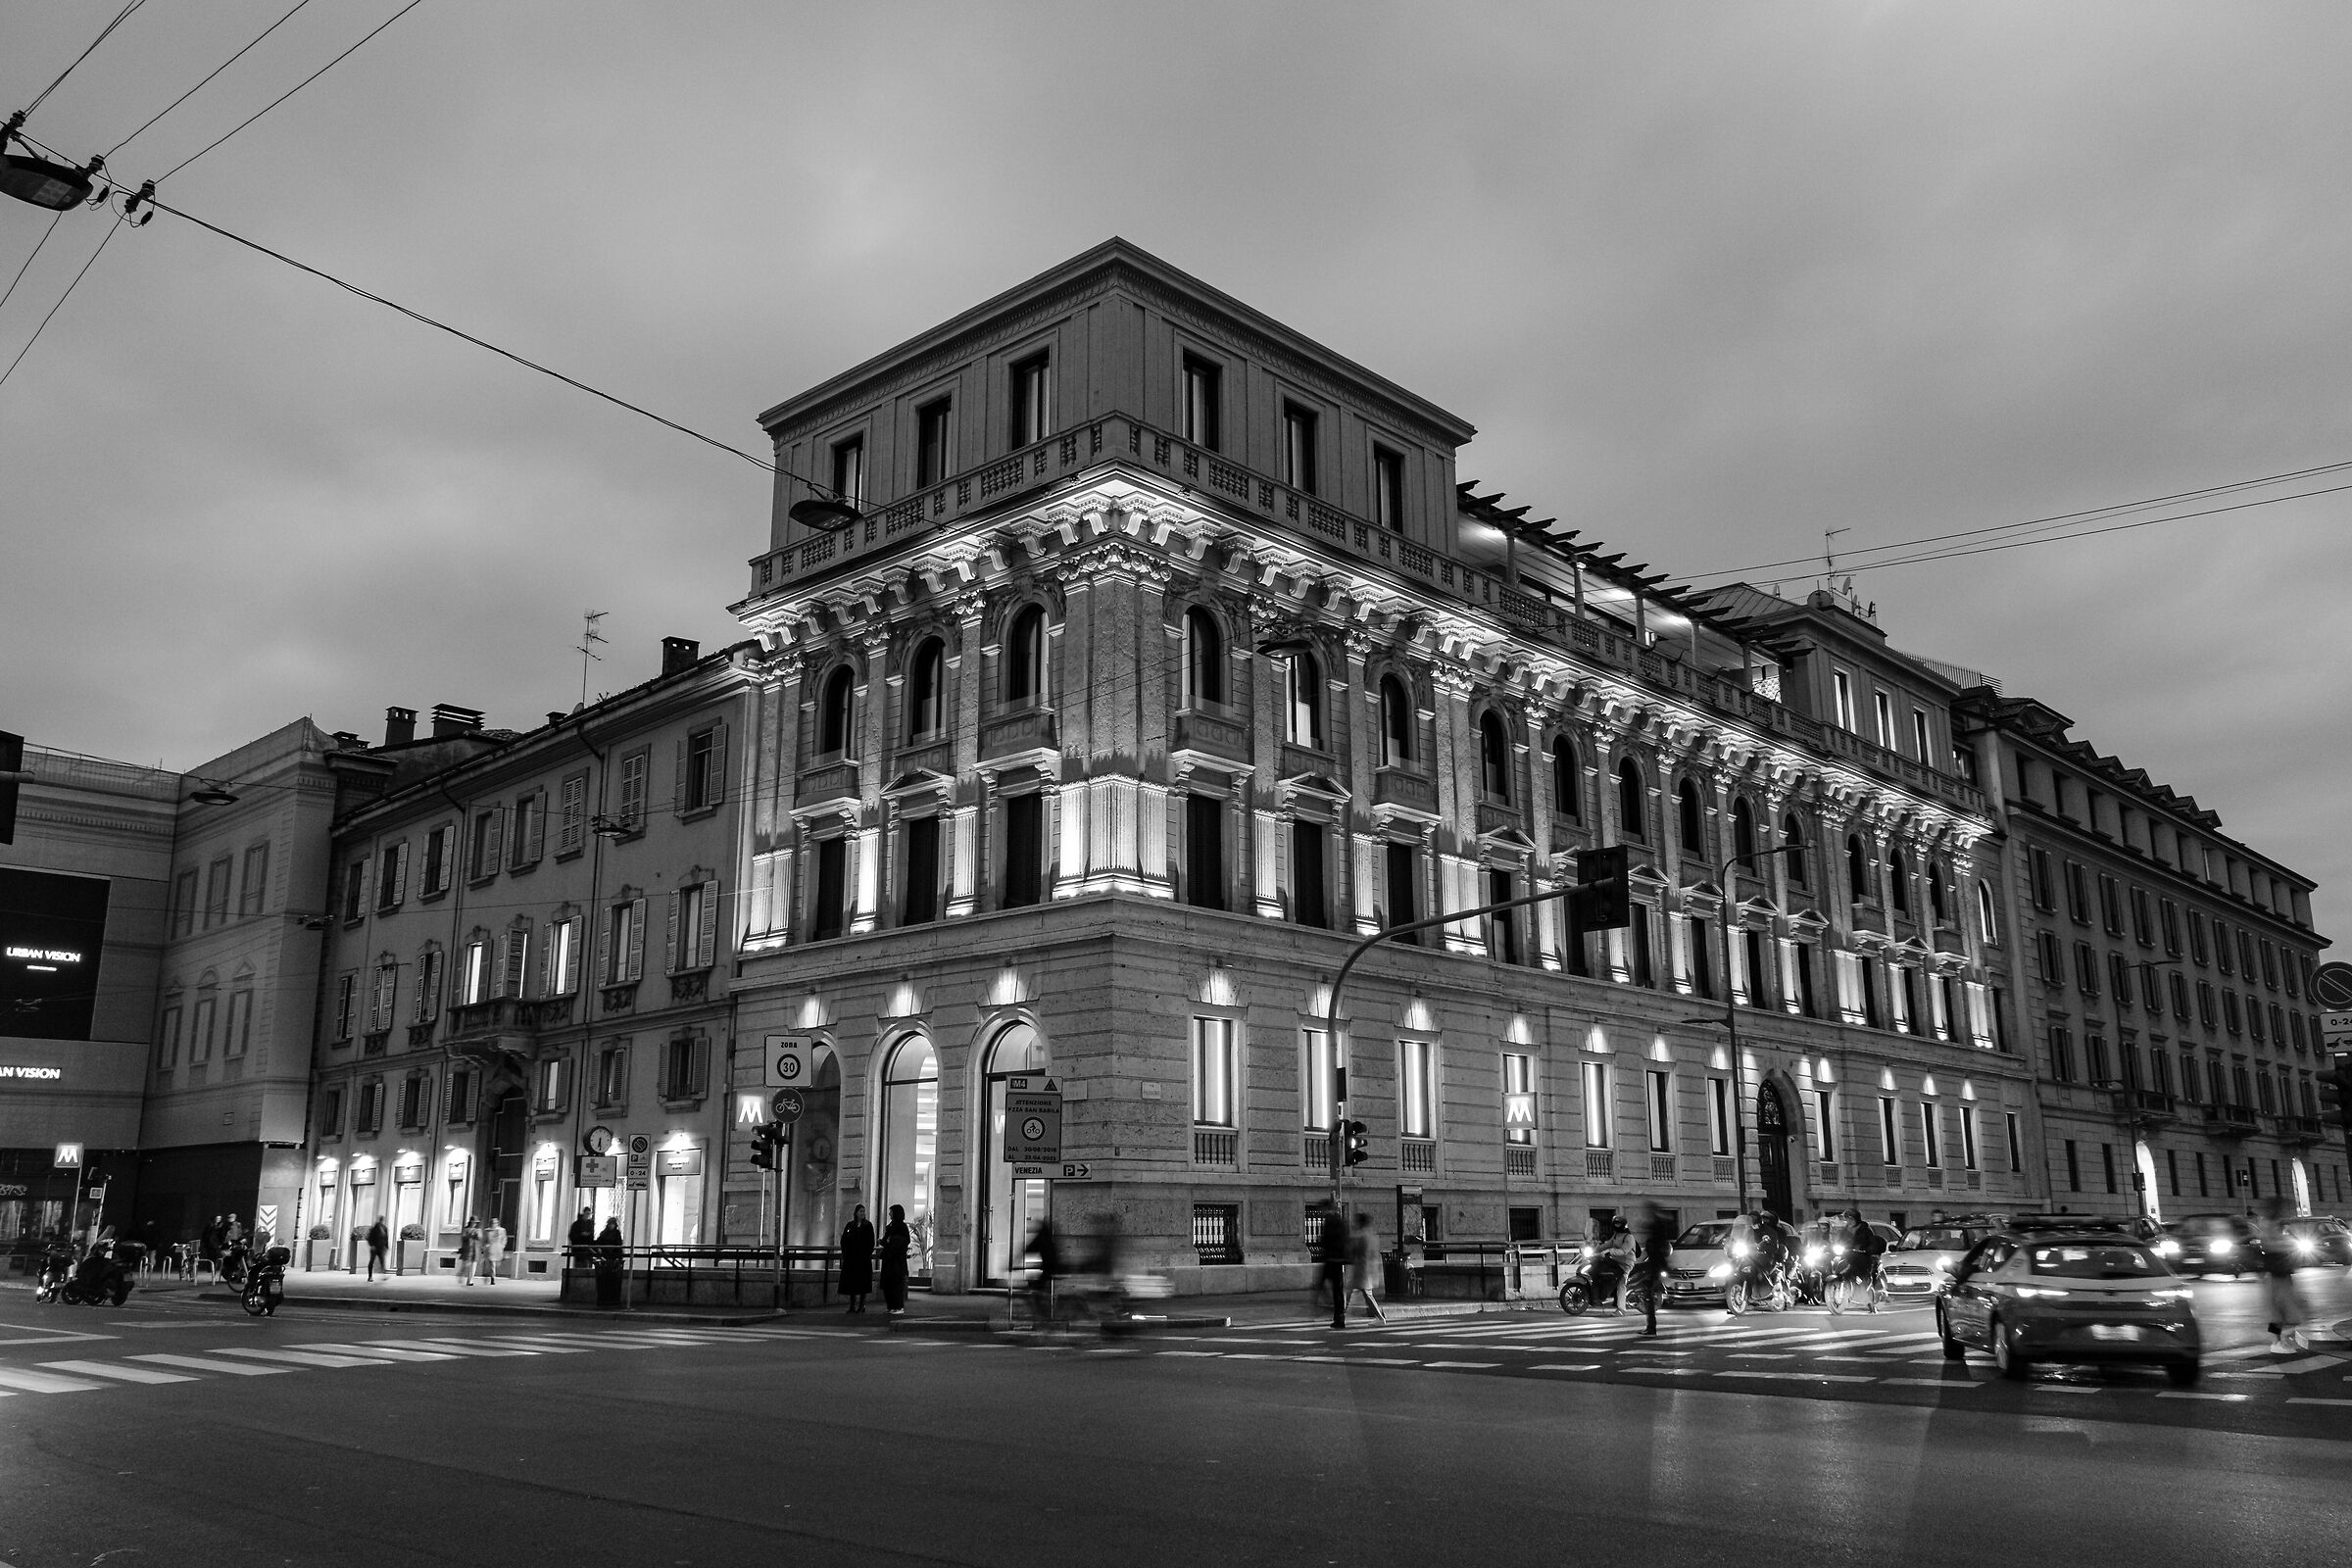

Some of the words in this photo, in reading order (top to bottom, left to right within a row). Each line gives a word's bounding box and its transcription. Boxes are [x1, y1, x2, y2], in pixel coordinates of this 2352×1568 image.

[6, 947, 43, 958] URBAN
[44, 950, 80, 962] VISION
[2330, 1017, 2352, 1026] 0-2
[16, 1066, 61, 1079] VISION
[783, 1062, 796, 1073] 30
[738, 1101, 763, 1123] M
[1506, 1101, 1533, 1122] M
[57, 1148, 78, 1163] M
